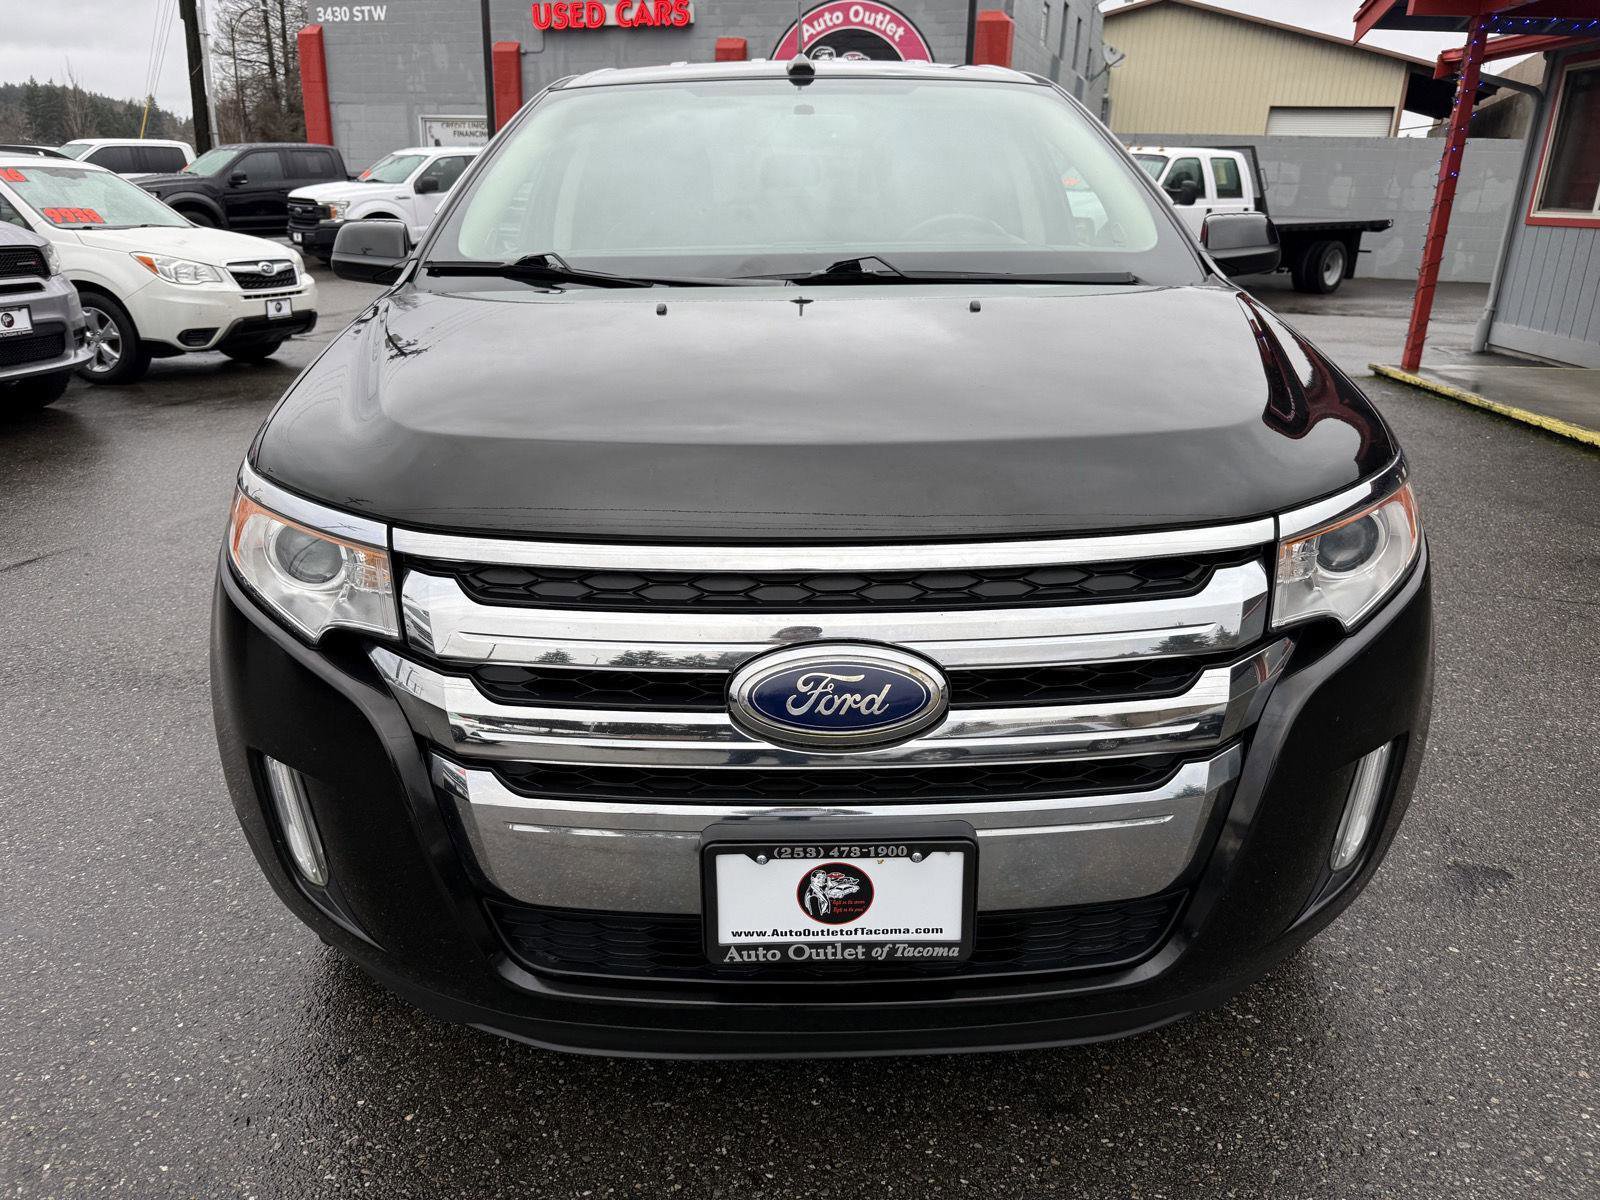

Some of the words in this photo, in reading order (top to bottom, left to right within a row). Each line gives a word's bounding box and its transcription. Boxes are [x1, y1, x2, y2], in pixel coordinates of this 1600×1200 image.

[316, 6, 350, 22] 3430
[352, 5, 387, 22] STW
[531, 1, 606, 30] USED
[614, 0, 690, 28] CARS
[801, 10, 844, 43] Auto
[849, 5, 905, 43] Outlet
[468, 120, 487, 129] UNIO
[453, 130, 488, 138] FINANCIN
[785, 672, 892, 716] Ford
[773, 846, 825, 859] (253)
[828, 845, 908, 858] 473-1900
[731, 926, 944, 938] www.AutoOutletofTacoma.com
[723, 946, 781, 963] Auto
[787, 943, 866, 961] Outlet
[871, 944, 890, 960] of
[894, 943, 959, 958] Tacoma
